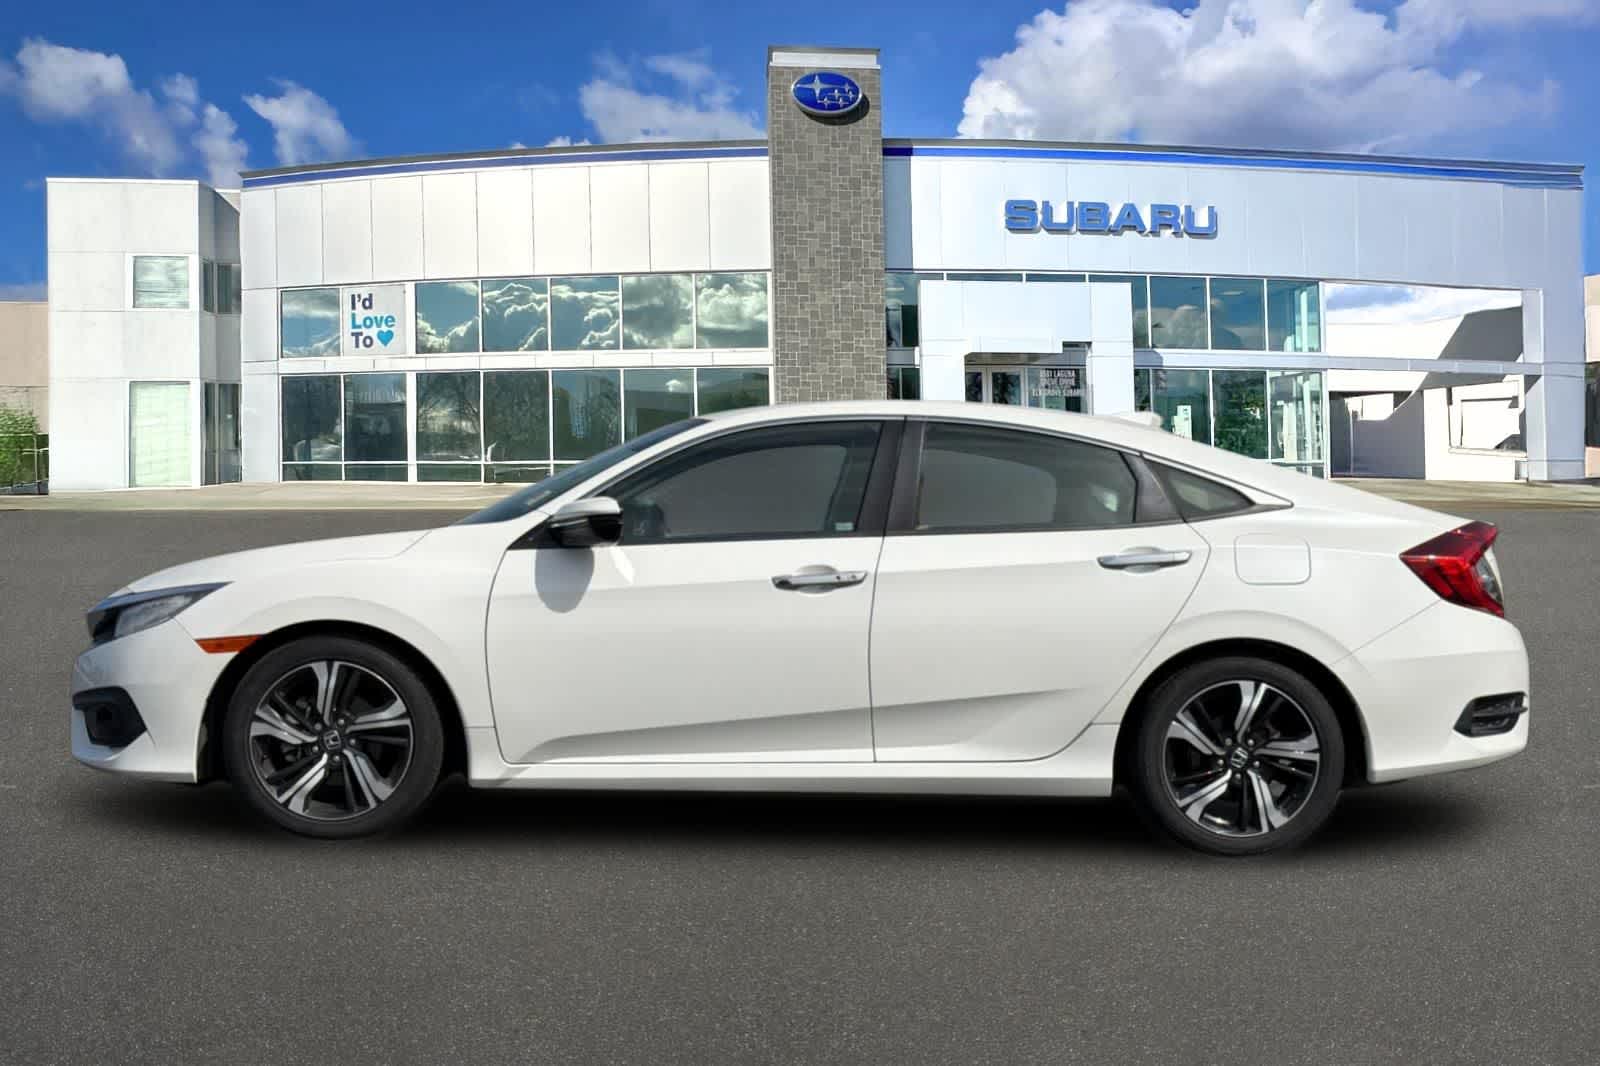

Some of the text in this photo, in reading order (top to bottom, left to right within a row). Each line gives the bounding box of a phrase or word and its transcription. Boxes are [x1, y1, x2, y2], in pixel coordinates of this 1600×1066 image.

[1005, 199, 1217, 238] SUBARU
[351, 312, 396, 329] Love
[351, 332, 373, 348] To
